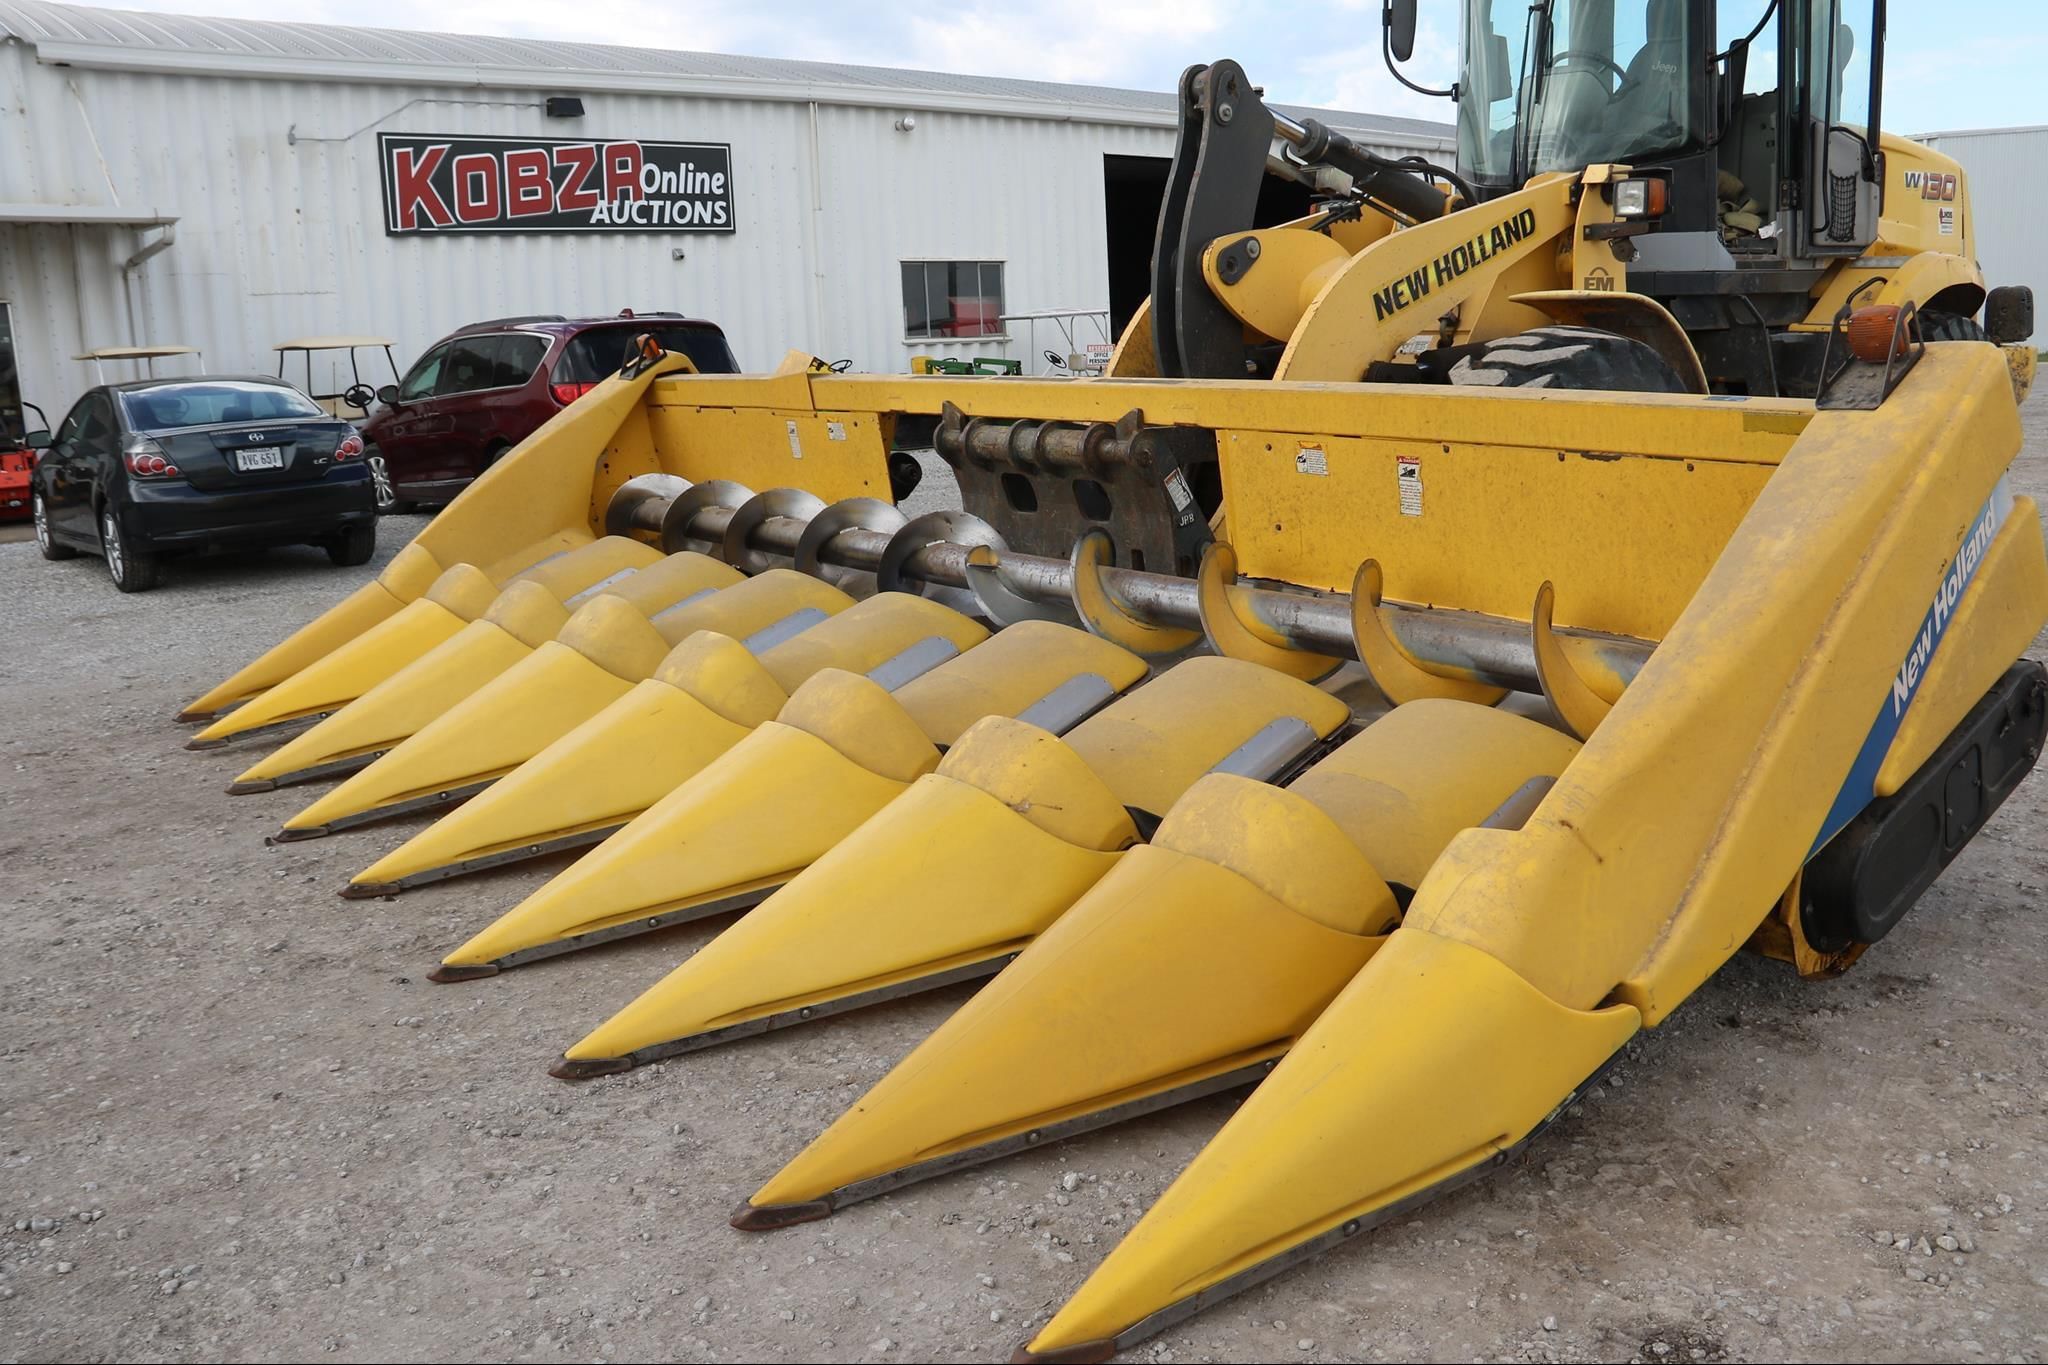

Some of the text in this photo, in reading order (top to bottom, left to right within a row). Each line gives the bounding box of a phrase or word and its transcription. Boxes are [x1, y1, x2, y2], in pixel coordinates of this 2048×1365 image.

[1651, 60, 1677, 75] Jeep
[392, 141, 725, 231] KOBZA Online
[590, 200, 727, 225] AUCTIONS
[1373, 208, 1536, 321] NEW HOLLAND
[260, 452, 278, 465] 651
[1893, 496, 1996, 718] New Holland
